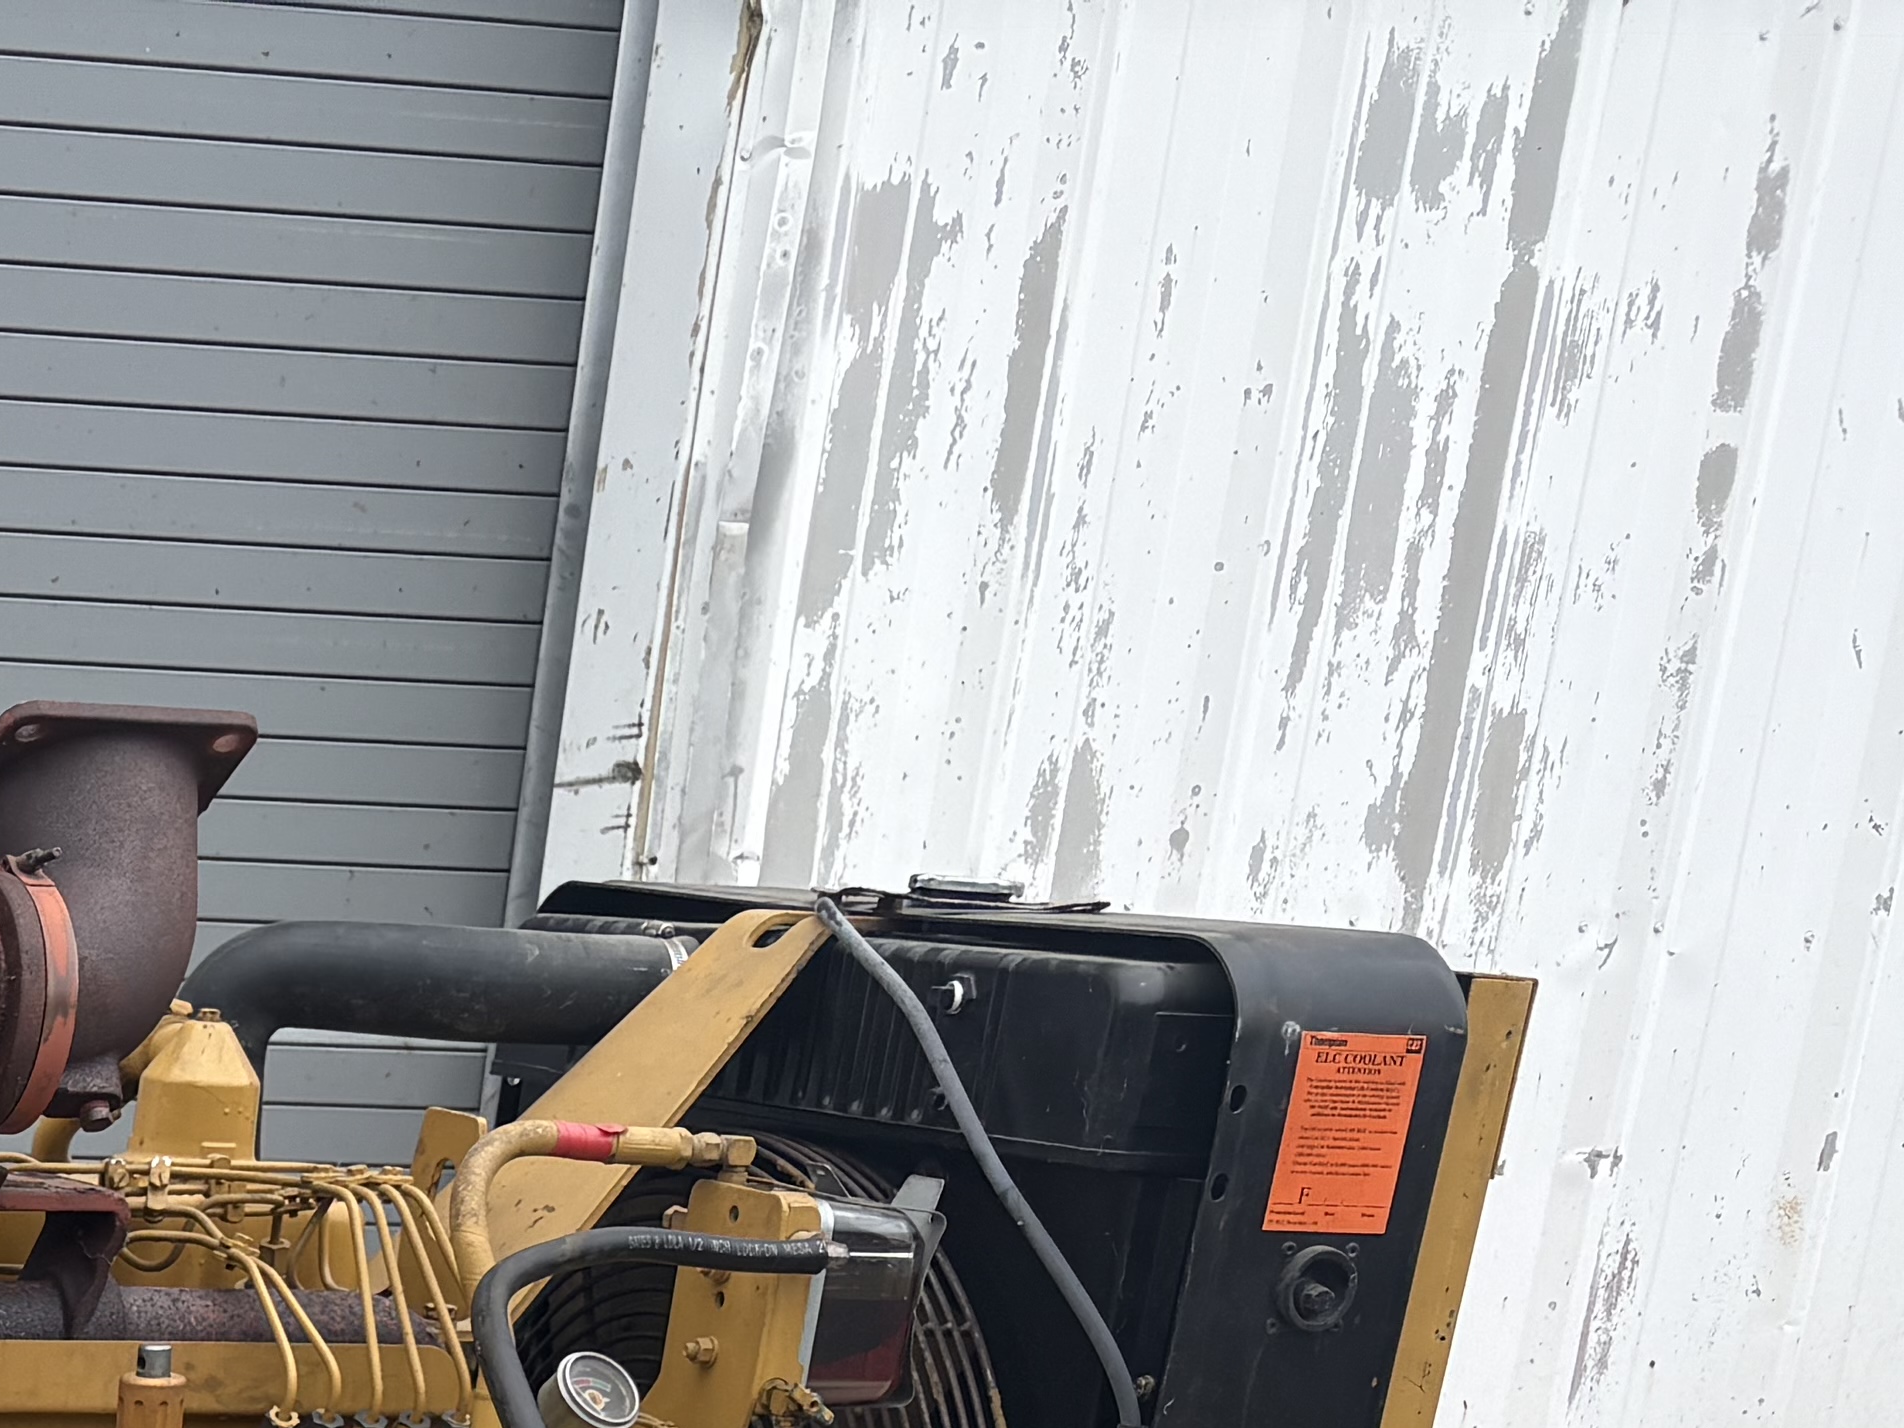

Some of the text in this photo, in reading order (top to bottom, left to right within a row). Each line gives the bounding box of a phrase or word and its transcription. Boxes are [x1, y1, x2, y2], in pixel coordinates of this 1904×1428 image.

[1315, 1051, 1406, 1067] ELC COOLANT
[1336, 1066, 1381, 1076] ATTENTION
[688, 1236, 704, 1251] 1/2
